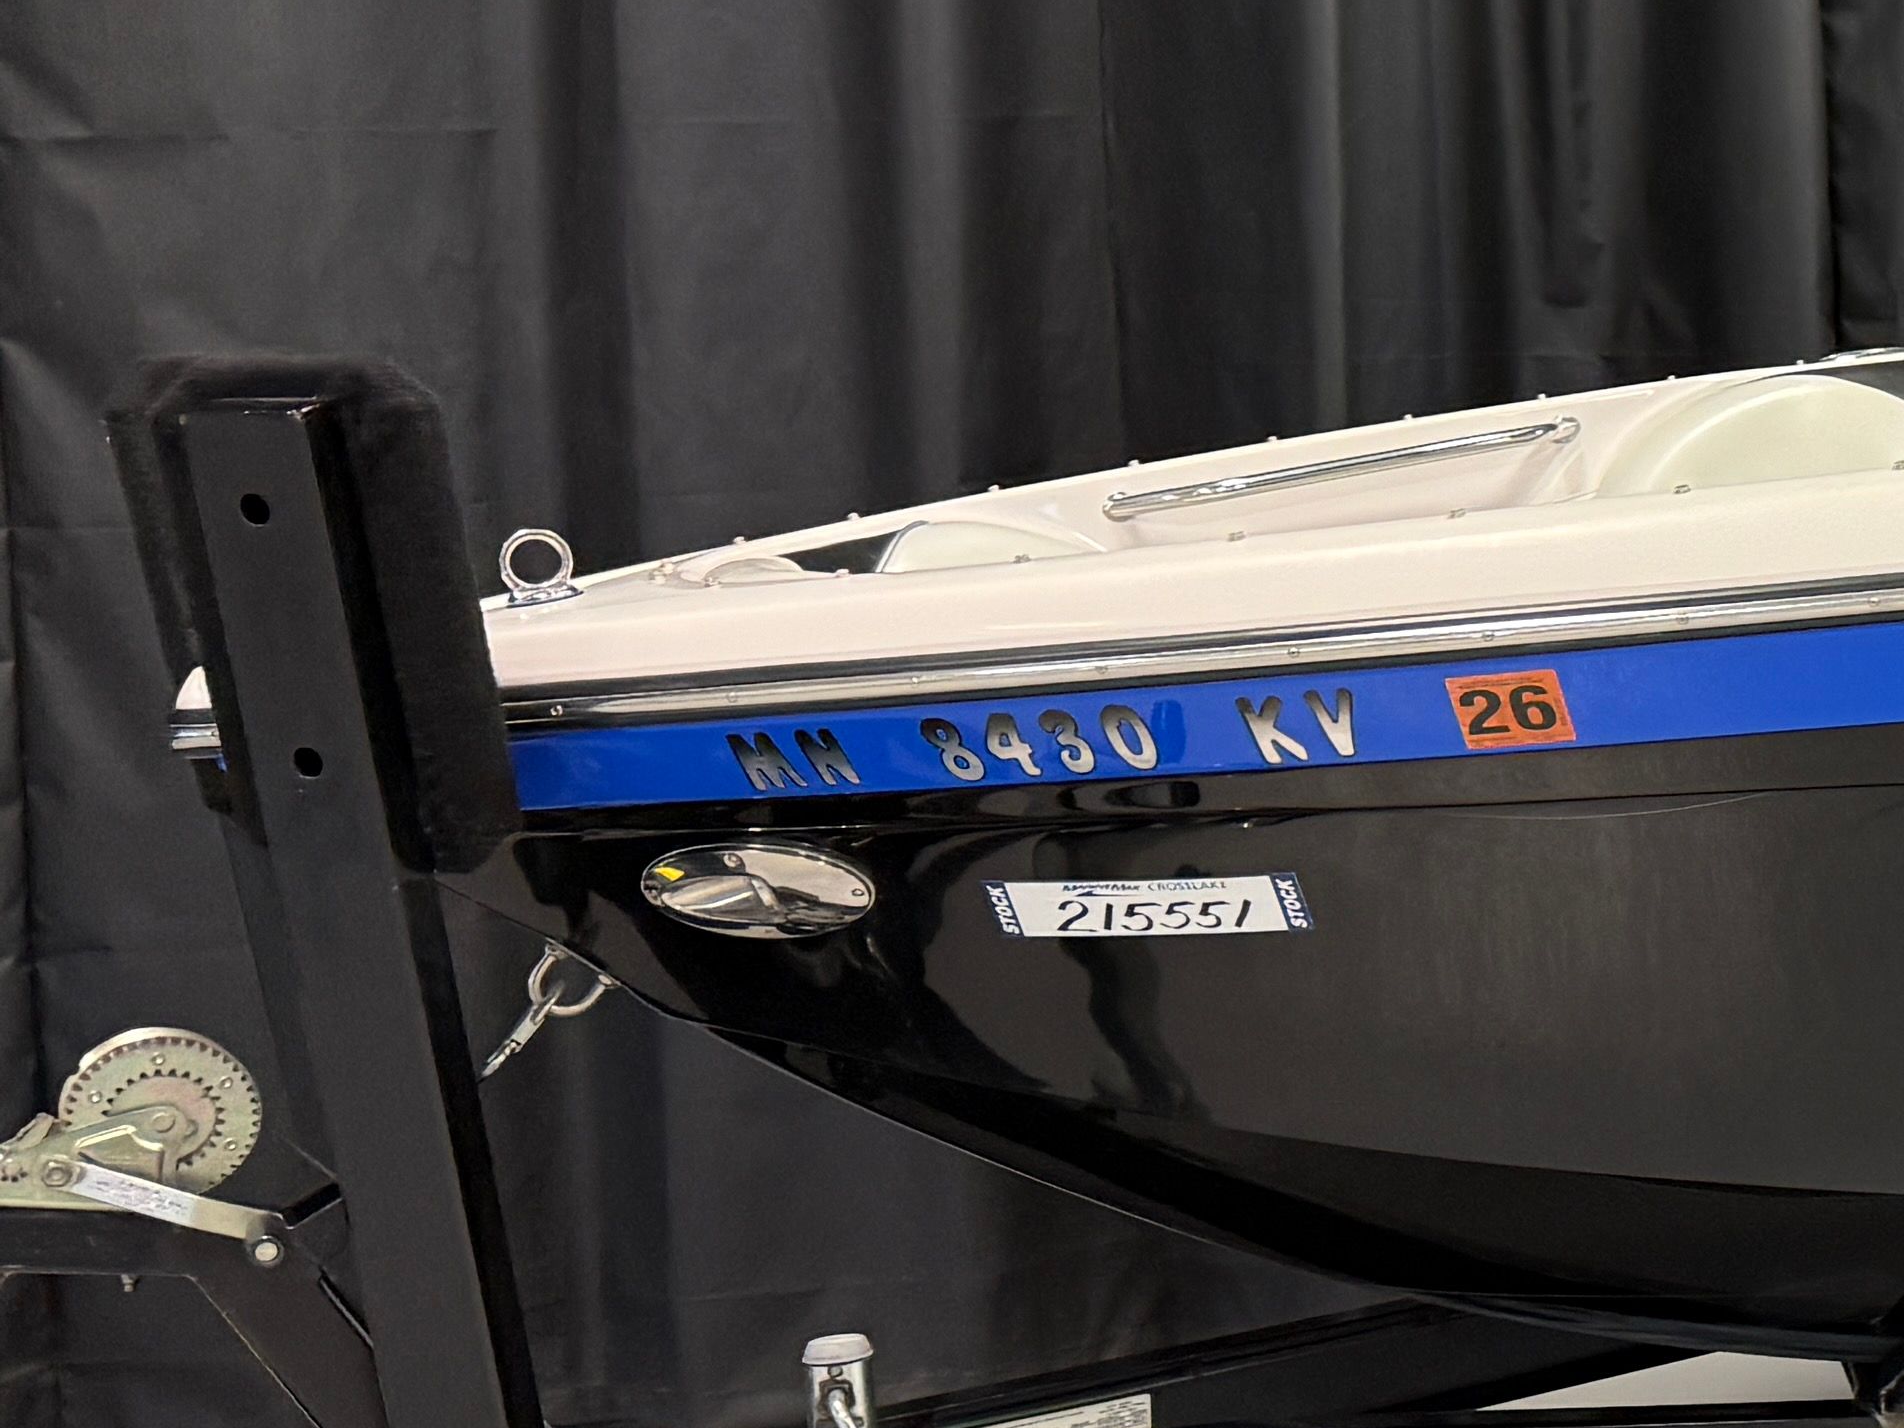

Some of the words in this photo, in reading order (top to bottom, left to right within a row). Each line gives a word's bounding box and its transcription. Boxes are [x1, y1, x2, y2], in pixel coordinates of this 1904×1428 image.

[1458, 681, 1558, 737] 26
[725, 726, 862, 793] MN
[919, 702, 1160, 782] 8430
[1236, 687, 1357, 766] KV
[985, 885, 1021, 936] STOCK
[1056, 899, 1252, 932] 215551
[1276, 878, 1308, 929] STOCK
